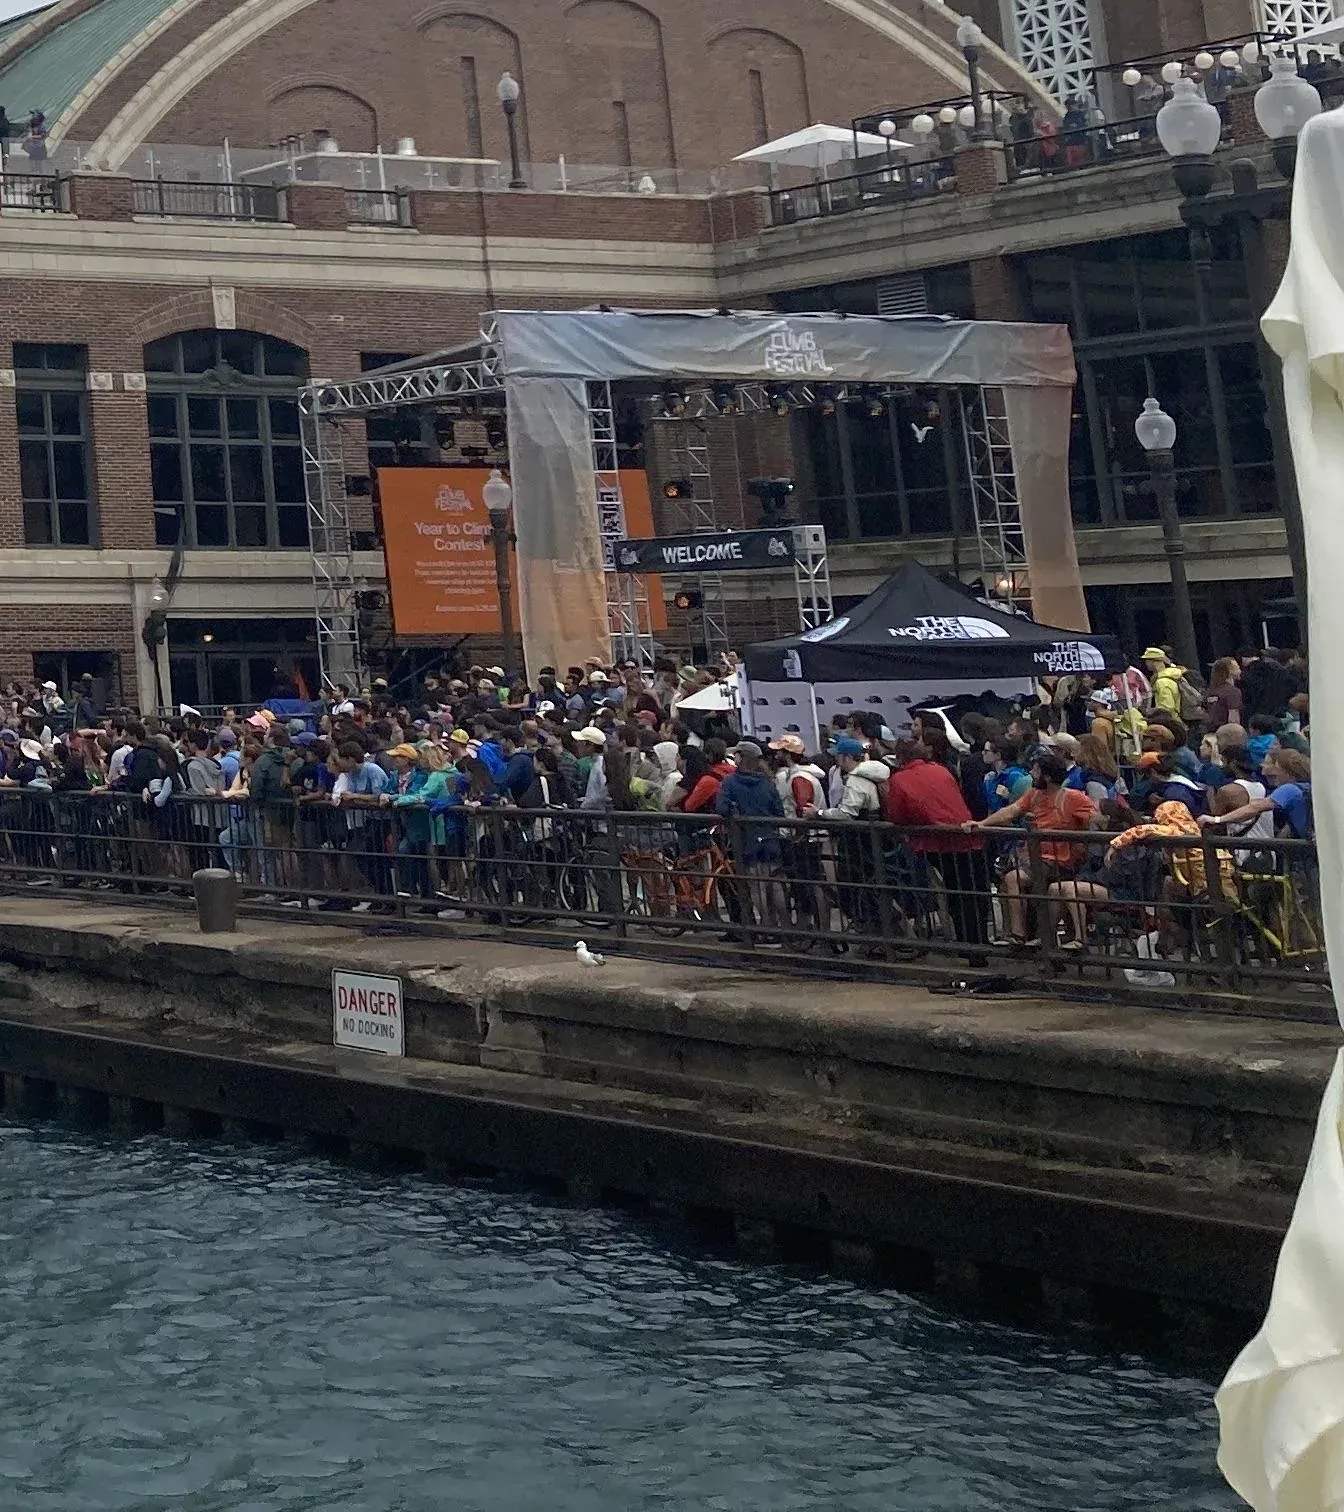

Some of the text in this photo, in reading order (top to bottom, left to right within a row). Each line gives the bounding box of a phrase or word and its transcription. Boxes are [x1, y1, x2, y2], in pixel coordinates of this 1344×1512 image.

[414, 522, 443, 535] Year
[446, 522, 461, 535] to
[433, 538, 486, 551] Contest
[662, 542, 743, 563] WELCOME
[915, 616, 958, 627] THE
[888, 626, 964, 637] NORTH
[1051, 641, 1078, 651] THE
[1034, 651, 1079, 662] NORTH
[1048, 661, 1081, 672] FACE
[338, 986, 397, 1017] DANGER
[342, 1017, 395, 1039] NO DOCKING
